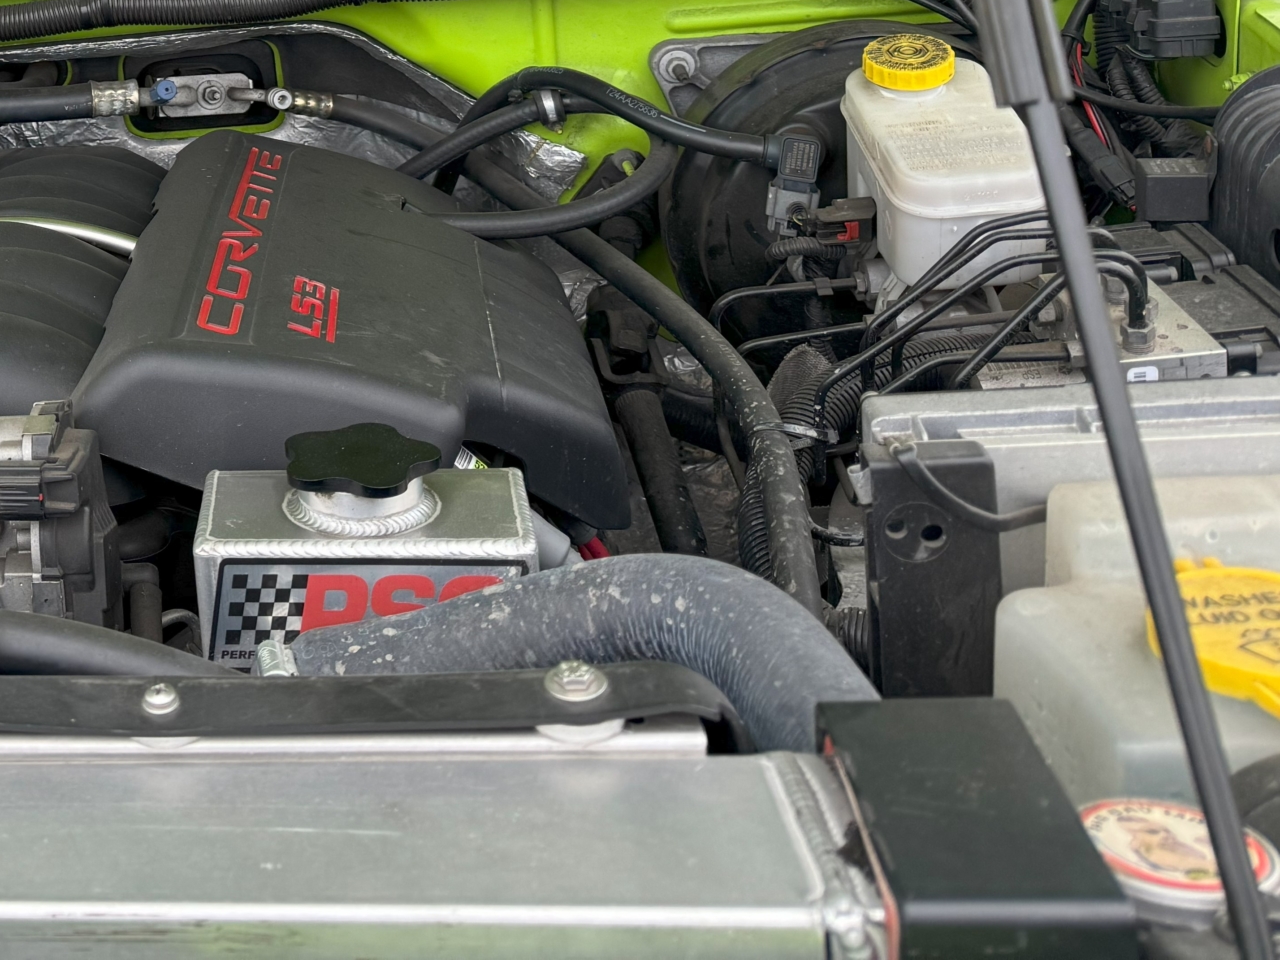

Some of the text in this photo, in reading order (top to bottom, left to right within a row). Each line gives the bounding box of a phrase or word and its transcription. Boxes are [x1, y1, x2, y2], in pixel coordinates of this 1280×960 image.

[196, 147, 283, 336] CORVETTE
[287, 275, 326, 339] LS3
[1182, 591, 1280, 609] ASHE
[1191, 610, 1251, 625] UID
[221, 650, 256, 659] PERF
